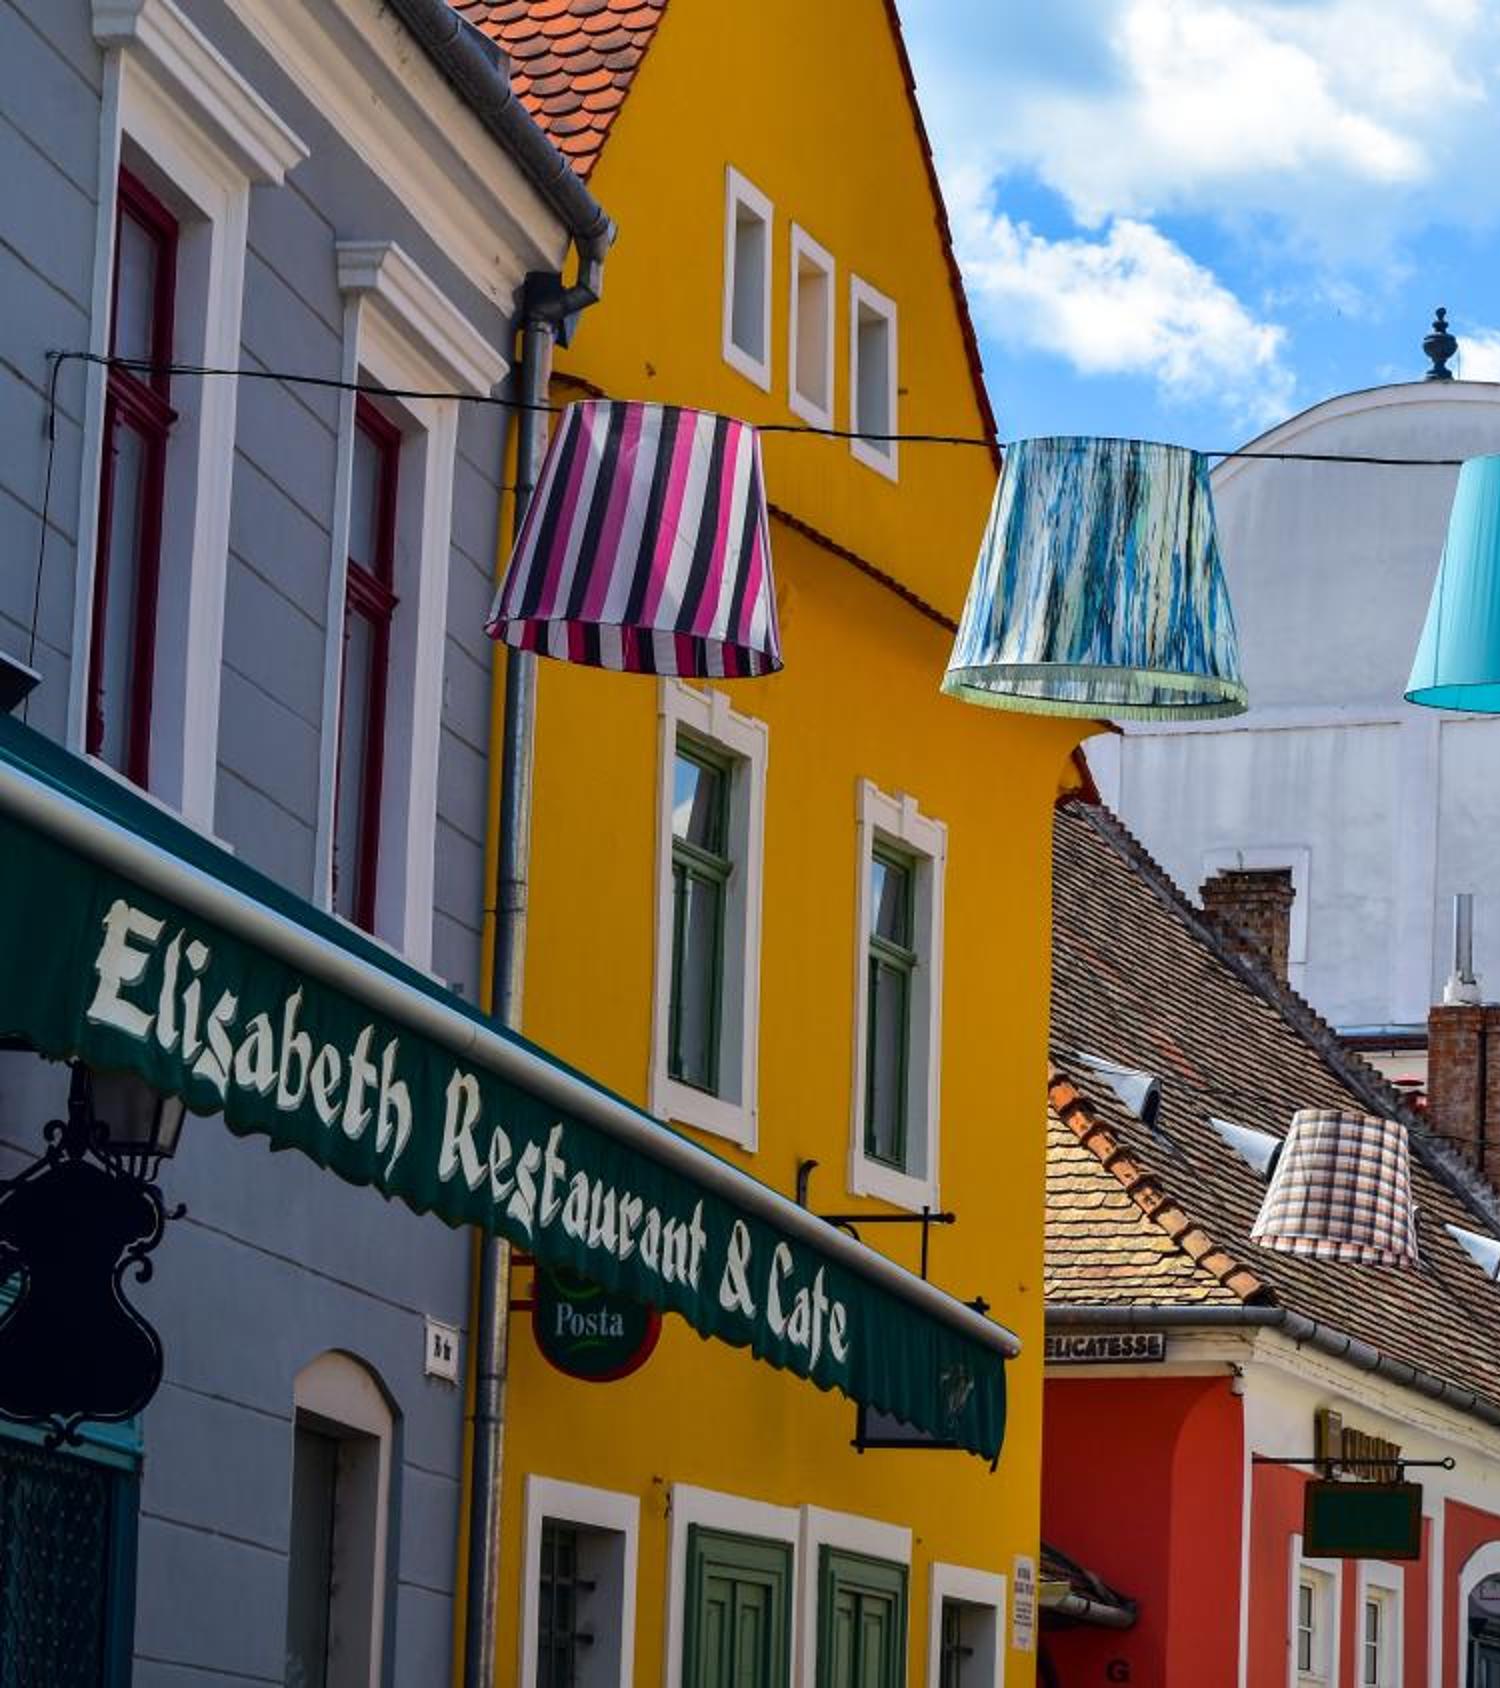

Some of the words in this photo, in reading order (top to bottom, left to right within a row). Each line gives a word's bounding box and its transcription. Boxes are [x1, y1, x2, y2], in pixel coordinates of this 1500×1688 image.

[87, 899, 413, 1181] Elisabeth
[438, 1068, 707, 1294] Restaurant
[719, 1218, 757, 1319] &
[767, 1240, 850, 1370] Cafe
[556, 1302, 625, 1337] Posta
